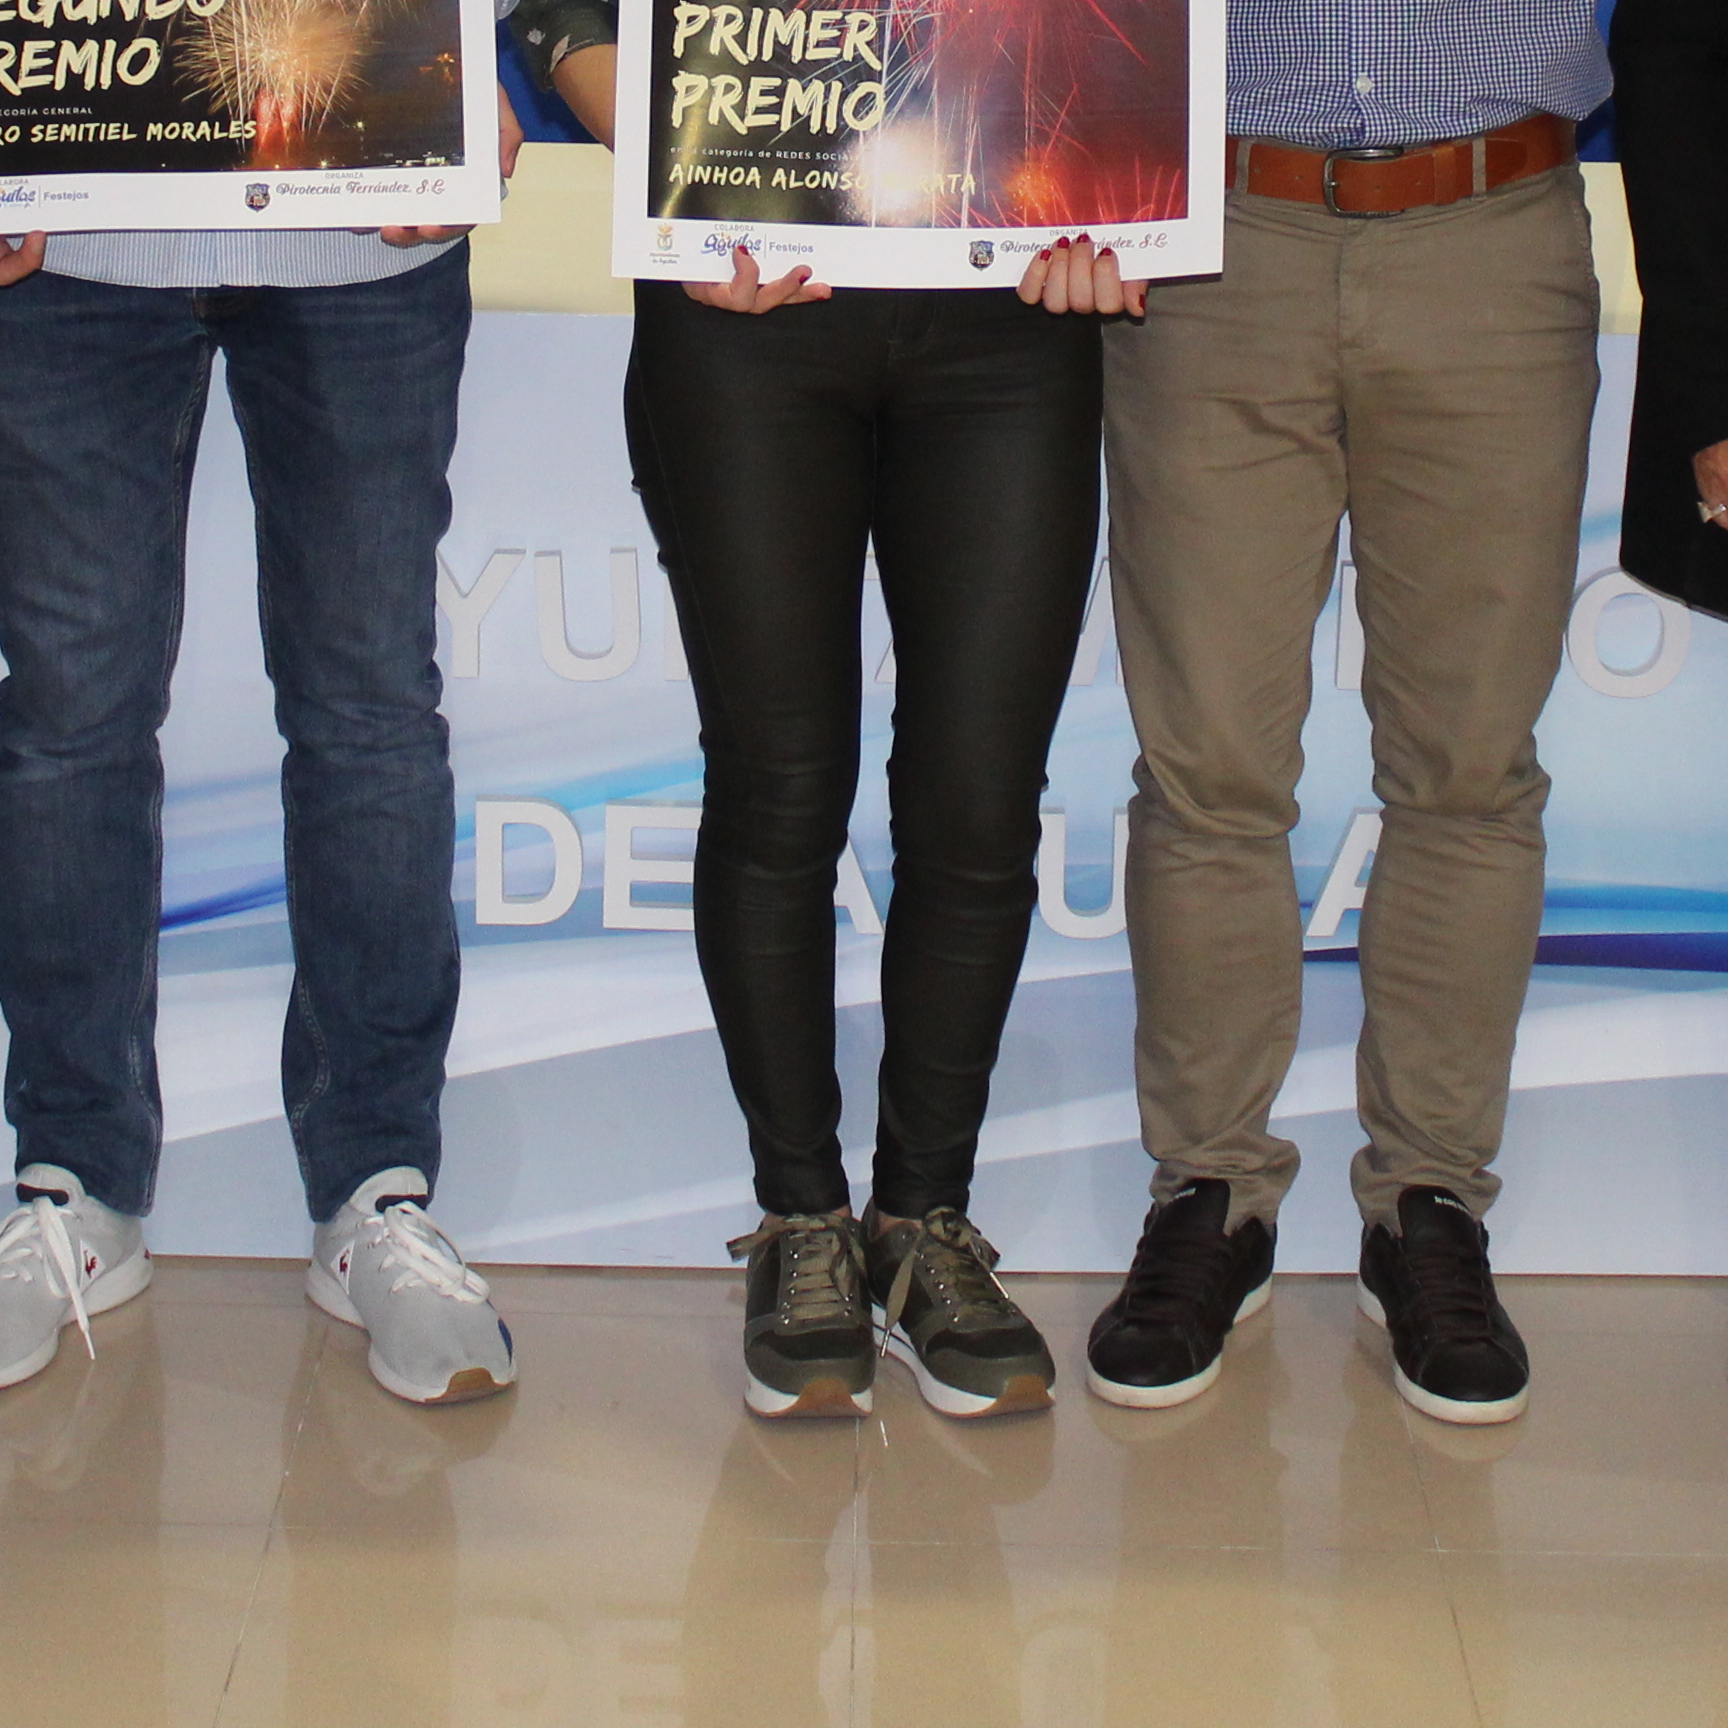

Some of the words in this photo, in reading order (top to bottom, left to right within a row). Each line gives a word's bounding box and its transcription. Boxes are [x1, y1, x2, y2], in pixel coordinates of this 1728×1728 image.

[673, 0, 884, 71] PRIMER
[671, 70, 886, 135] PREMIO
[42, 107, 93, 116] GENERAL
[30, 121, 137, 144] SEMITIEL
[146, 120, 258, 143] MORALES
[702, 148, 754, 159] categoría
[758, 149, 772, 158] de
[775, 150, 811, 160] REDES
[669, 163, 762, 190] AINHOA
[276, 182, 341, 195] Pirotecnia
[43, 191, 90, 202] Festejos
[714, 223, 755, 232] COLABORA
[769, 241, 815, 254] Festejos
[475, 794, 696, 930] DE
